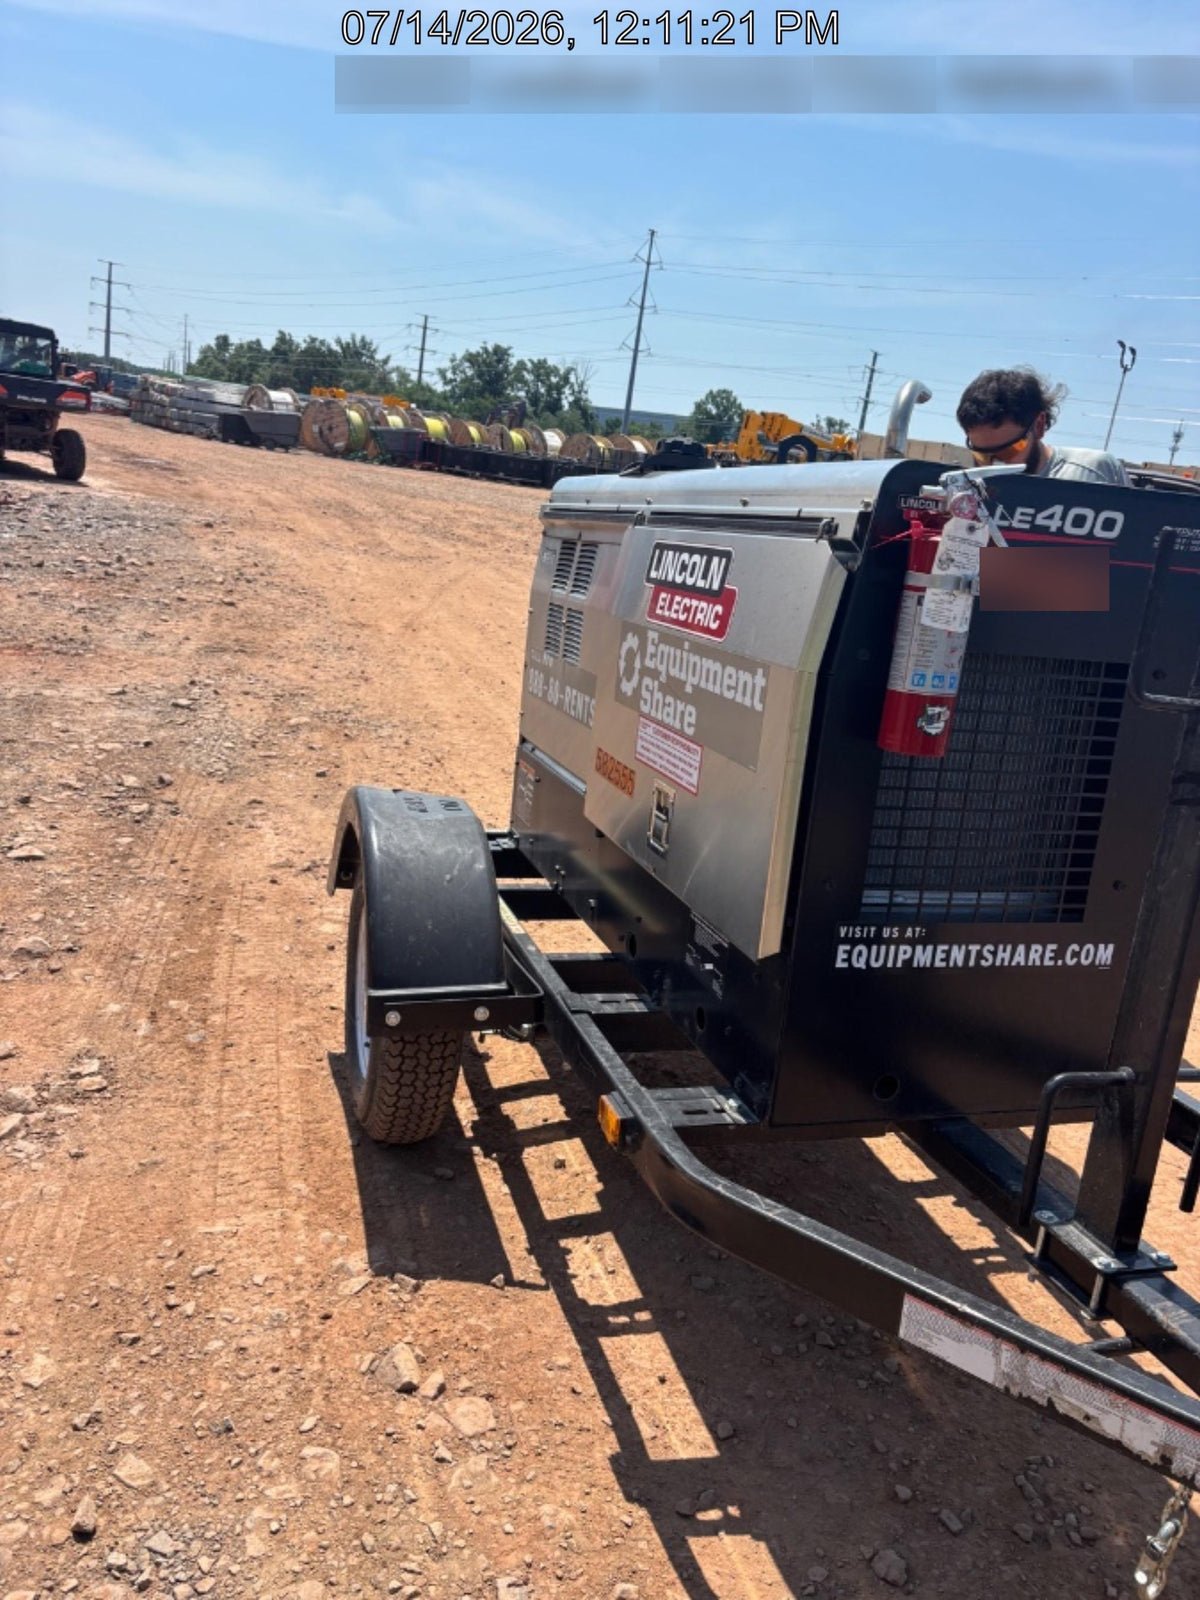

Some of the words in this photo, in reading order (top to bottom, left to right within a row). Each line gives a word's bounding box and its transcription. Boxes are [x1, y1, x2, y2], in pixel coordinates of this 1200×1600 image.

[994, 504, 1125, 539] LE400
[650, 548, 727, 592] LINCOLN
[656, 592, 723, 629] ELECTRIC
[644, 629, 767, 711] Equipment
[639, 682, 696, 736] Share
[839, 926, 877, 938] VISIT
[882, 927, 899, 938] US
[905, 927, 926, 938] AT:
[835, 944, 1114, 969] EQUIPMENTSHARE.COM
